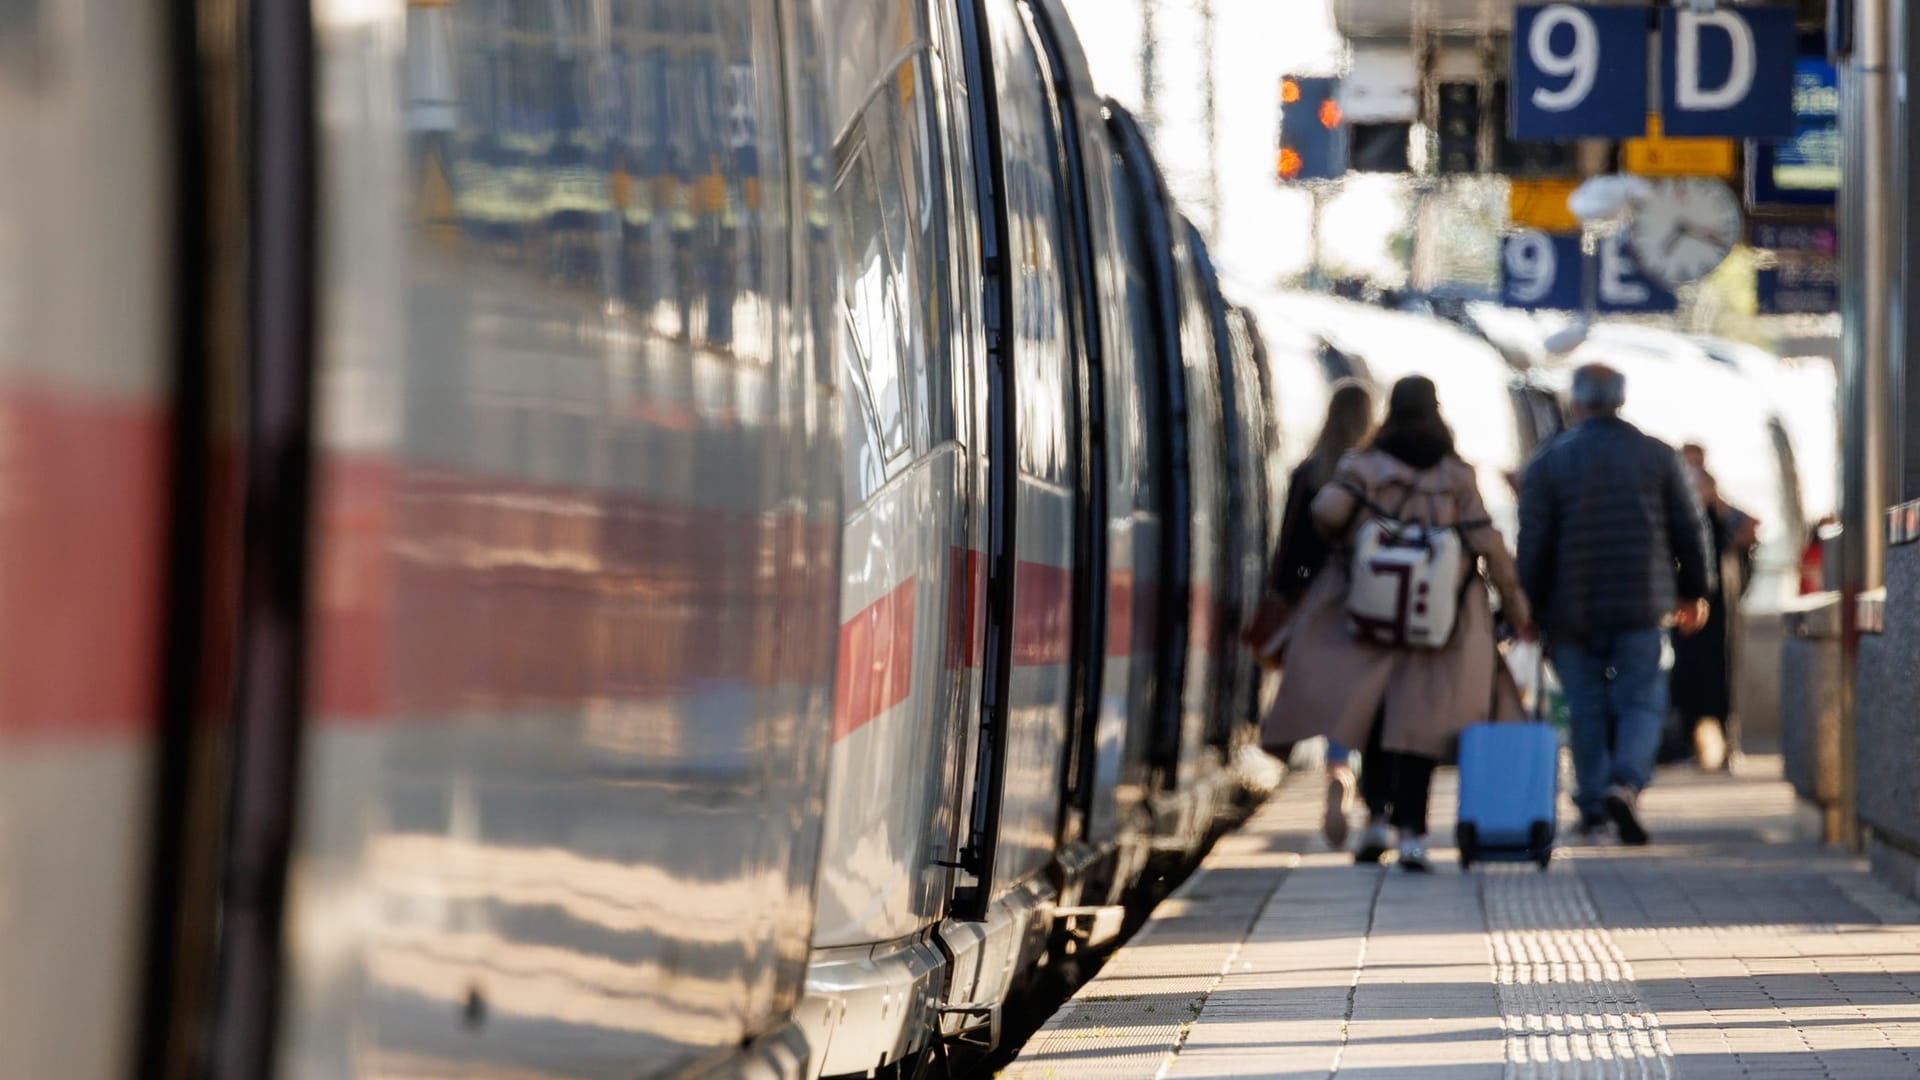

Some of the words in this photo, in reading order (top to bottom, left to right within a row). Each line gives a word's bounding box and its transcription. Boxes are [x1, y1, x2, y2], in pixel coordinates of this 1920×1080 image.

[1528, 5, 1600, 112] 9
[1674, 8, 1757, 111] D
[1505, 230, 1559, 302] 9
[1601, 234, 1650, 304] E
